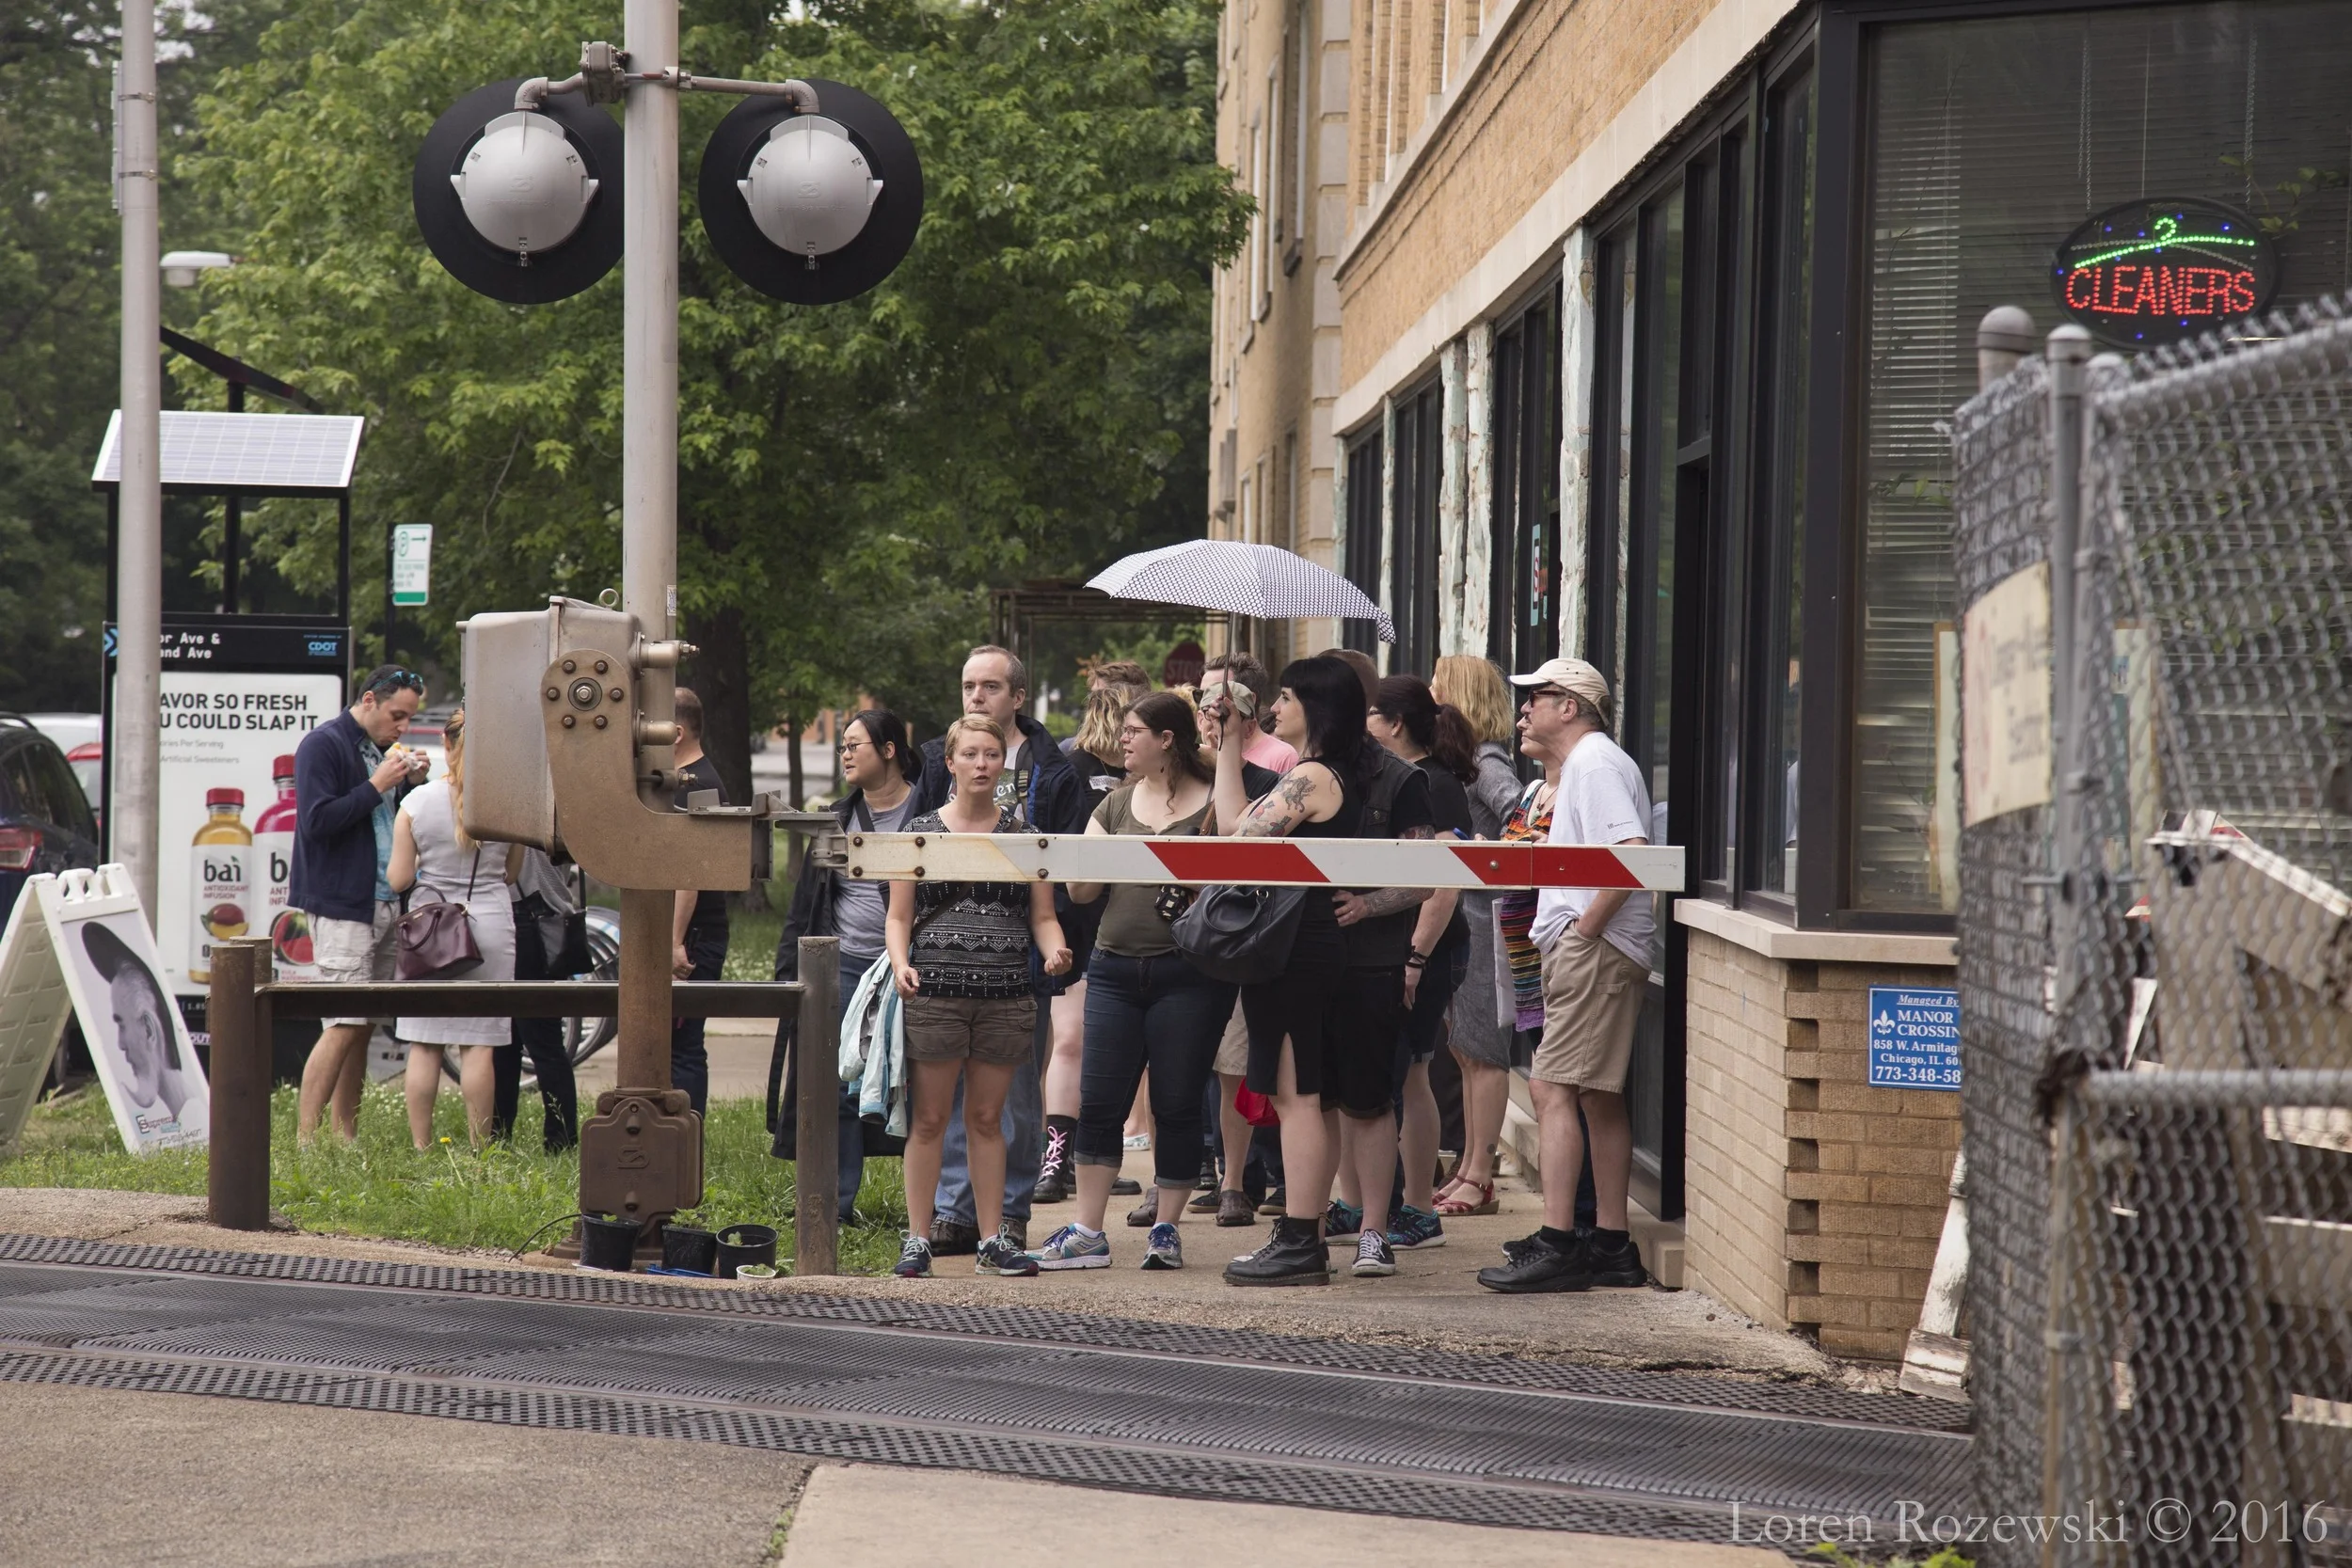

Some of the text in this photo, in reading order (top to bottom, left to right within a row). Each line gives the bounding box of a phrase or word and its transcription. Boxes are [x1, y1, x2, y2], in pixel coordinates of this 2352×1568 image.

[2065, 264, 2256, 315] CLEANERS
[160, 632, 221, 644] or Ave &
[160, 646, 213, 659] and Ave
[308, 641, 338, 651] CDOT
[160, 692, 307, 711] AVOR SO FRESH
[160, 713, 318, 731] U COULD SLAP IT
[160, 738, 224, 750] ories Per Serving
[203, 856, 242, 882] bai
[1899, 994, 1960, 1007] Managed By
[1897, 1009, 1954, 1023] MANOR
[1897, 1023, 1961, 1038] CROSSIN
[1873, 1039, 1960, 1055] 858 W. Armitag
[1881, 1053, 1961, 1066] Chicago, IL. 60
[1875, 1066, 1962, 1084] 773-348-58
